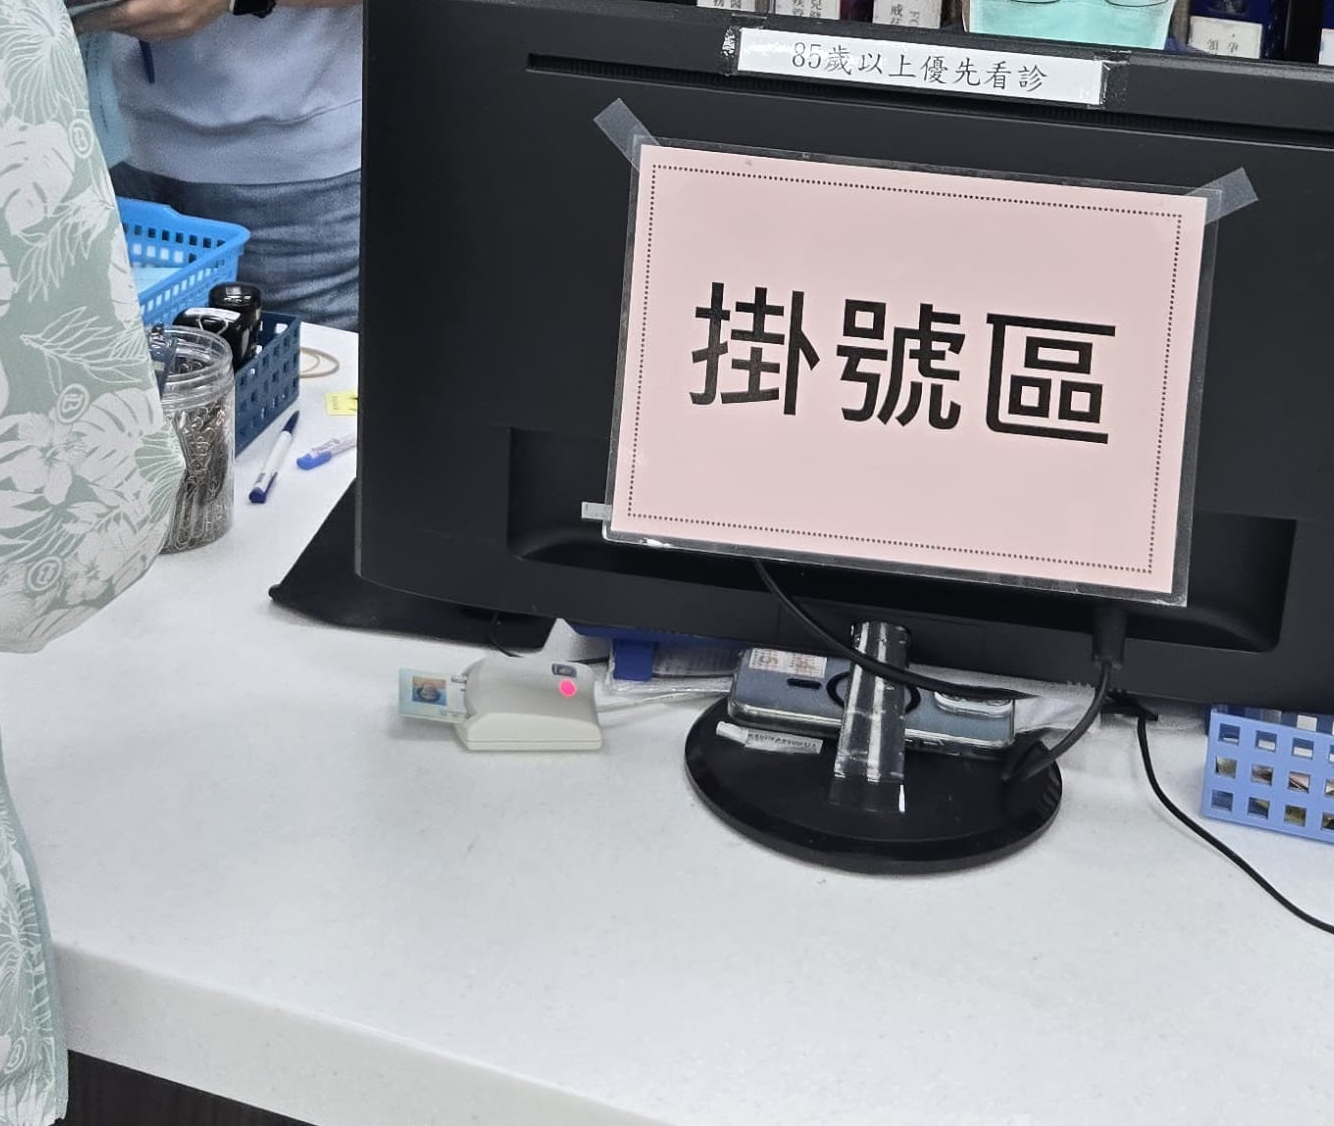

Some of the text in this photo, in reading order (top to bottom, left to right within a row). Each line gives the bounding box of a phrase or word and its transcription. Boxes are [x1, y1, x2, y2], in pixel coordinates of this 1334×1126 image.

[791, 41, 1048, 92] 85歲以上優先看診
[688, 281, 1116, 445] 掛號區
